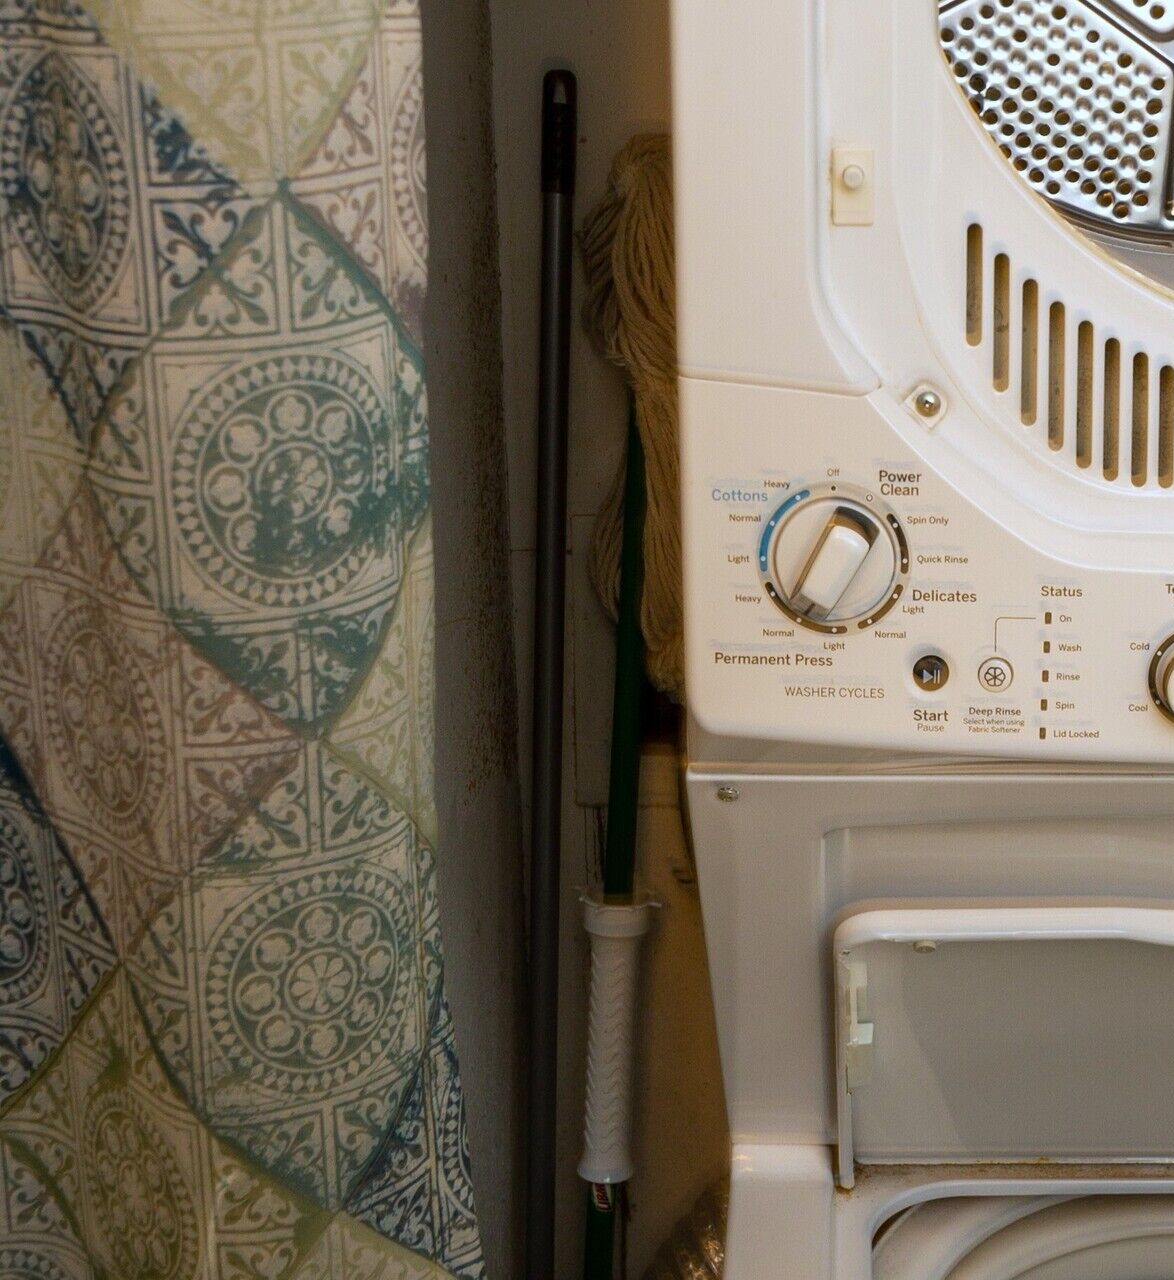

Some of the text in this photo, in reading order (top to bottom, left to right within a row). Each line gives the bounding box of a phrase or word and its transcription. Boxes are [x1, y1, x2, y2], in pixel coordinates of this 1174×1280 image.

[827, 468, 840, 477] Off
[879, 471, 922, 484] Power
[764, 479, 791, 490] Heavy
[880, 484, 919, 496] Clean
[712, 489, 768, 503] Cottons
[729, 514, 761, 522] Normal
[907, 516, 949, 526] Spin Only
[728, 554, 749, 564] Light
[917, 555, 968, 565] Quick Rinse
[912, 590, 977, 602] Delicates
[1041, 587, 1082, 597] Status
[735, 594, 761, 604] Heavy
[902, 605, 924, 614] Light
[762, 628, 794, 638] Normal
[875, 630, 906, 639] Normal
[823, 641, 845, 651] Light
[715, 653, 833, 667] Permanent Press
[785, 687, 885, 698] WASHER CYCLES
[1056, 702, 1075, 710] Spin
[1129, 704, 1148, 712] Cool
[913, 710, 948, 722] Start
[969, 707, 1021, 716] Deep Rinse
[917, 723, 944, 732] Pause
[1054, 730, 1067, 738] Lid
